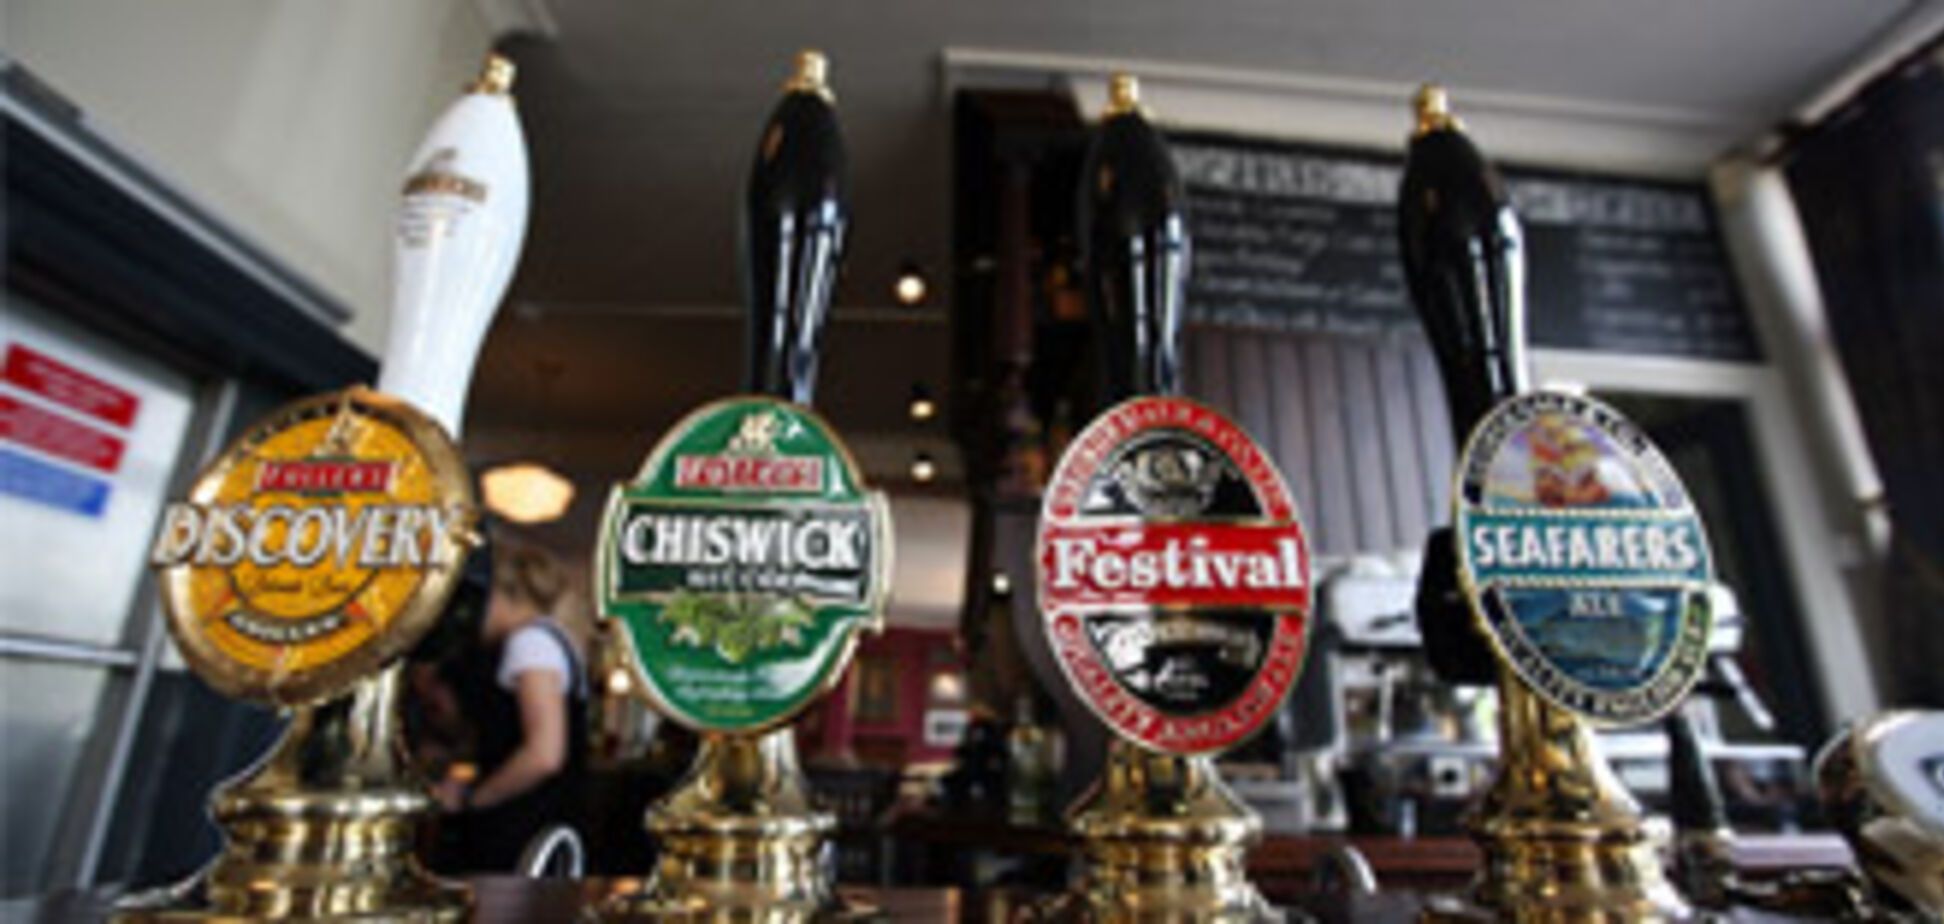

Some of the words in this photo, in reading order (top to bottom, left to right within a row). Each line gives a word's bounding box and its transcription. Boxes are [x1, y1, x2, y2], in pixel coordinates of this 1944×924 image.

[152, 503, 454, 569] DISCOVERY
[622, 514, 863, 568] CHISWICK
[1052, 535, 1304, 589] Festival
[1472, 524, 1698, 569] SEAFARERS
